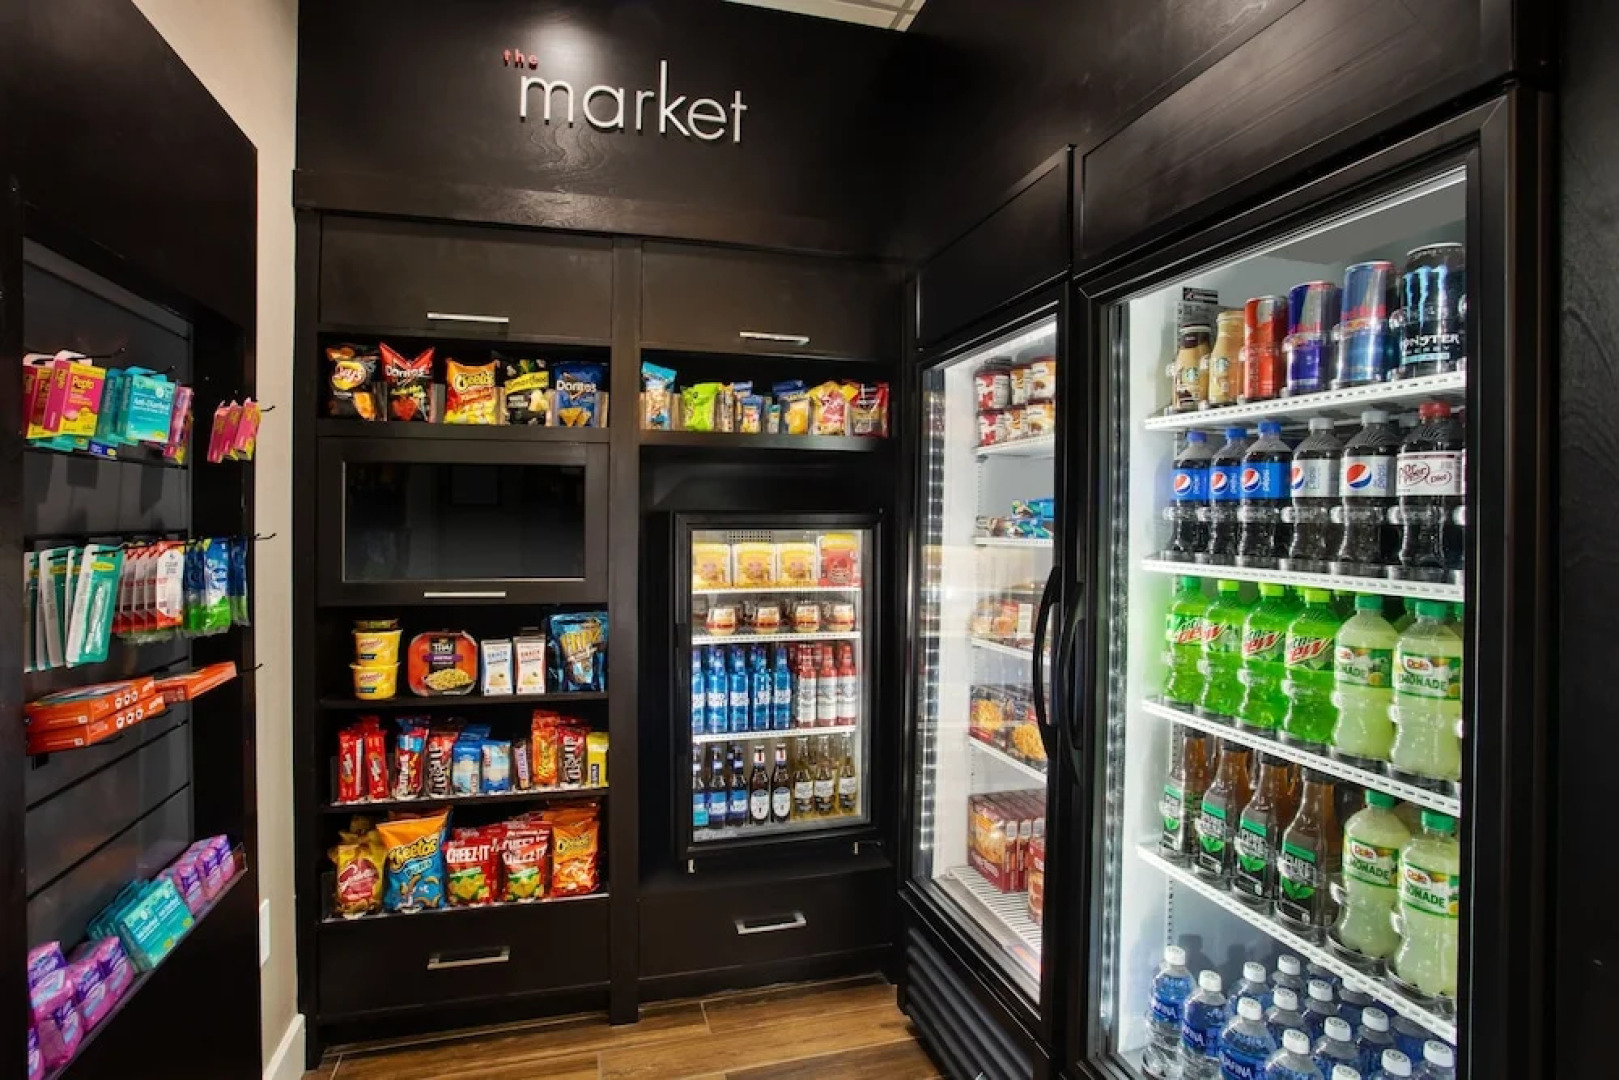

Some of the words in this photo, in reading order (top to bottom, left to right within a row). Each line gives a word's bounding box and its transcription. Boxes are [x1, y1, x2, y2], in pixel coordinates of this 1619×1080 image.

[503, 49, 538, 69] the
[519, 59, 748, 143] market
[556, 379, 597, 393] Doritos
[388, 837, 438, 873] Cheetos
[446, 843, 491, 864] CHEEZ-IT
